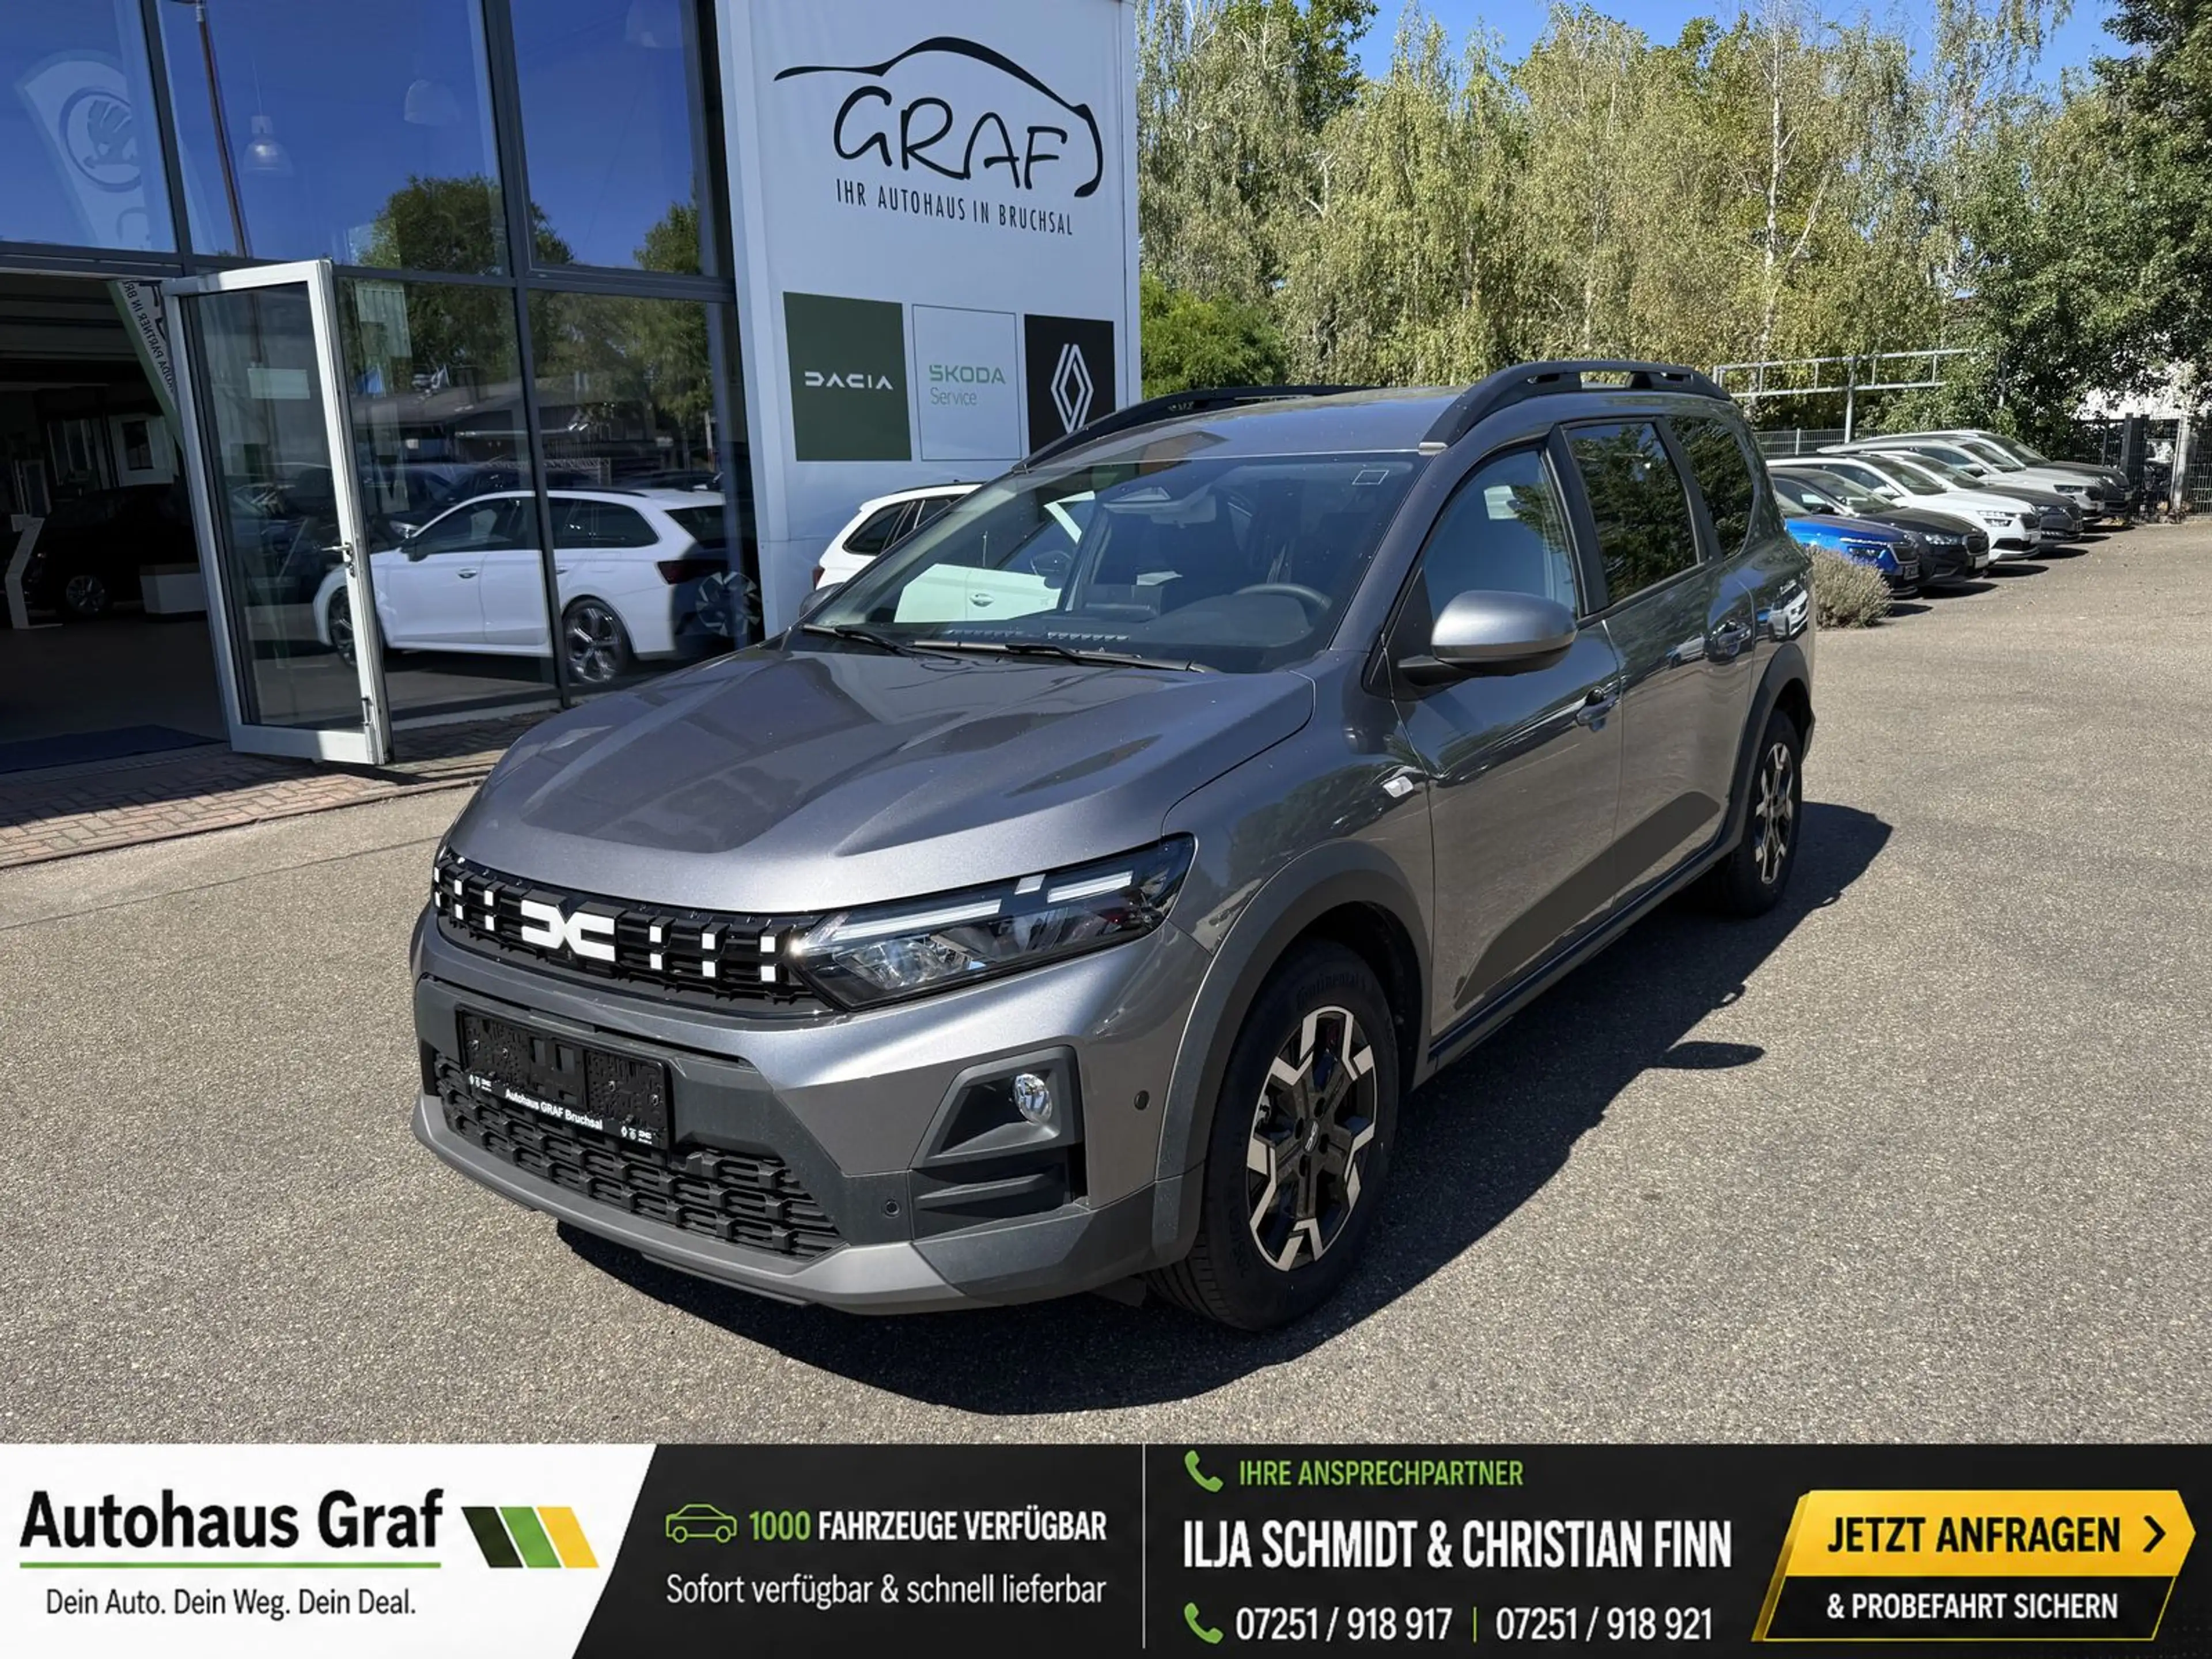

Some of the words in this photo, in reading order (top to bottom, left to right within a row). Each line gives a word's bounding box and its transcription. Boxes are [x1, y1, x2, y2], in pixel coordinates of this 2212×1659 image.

[834, 85, 1068, 190] GRAF
[836, 179, 866, 206] IHR
[878, 185, 965, 221] AUTOHAUS
[974, 200, 989, 224] IN
[999, 204, 1073, 236] BRUCHSAL
[805, 372, 893, 389] DACIA
[930, 387, 977, 406] Service
[505, 1089, 539, 1109] Autohaus
[540, 1101, 563, 1118] GRAF
[565, 1109, 603, 1130] Bruchsal
